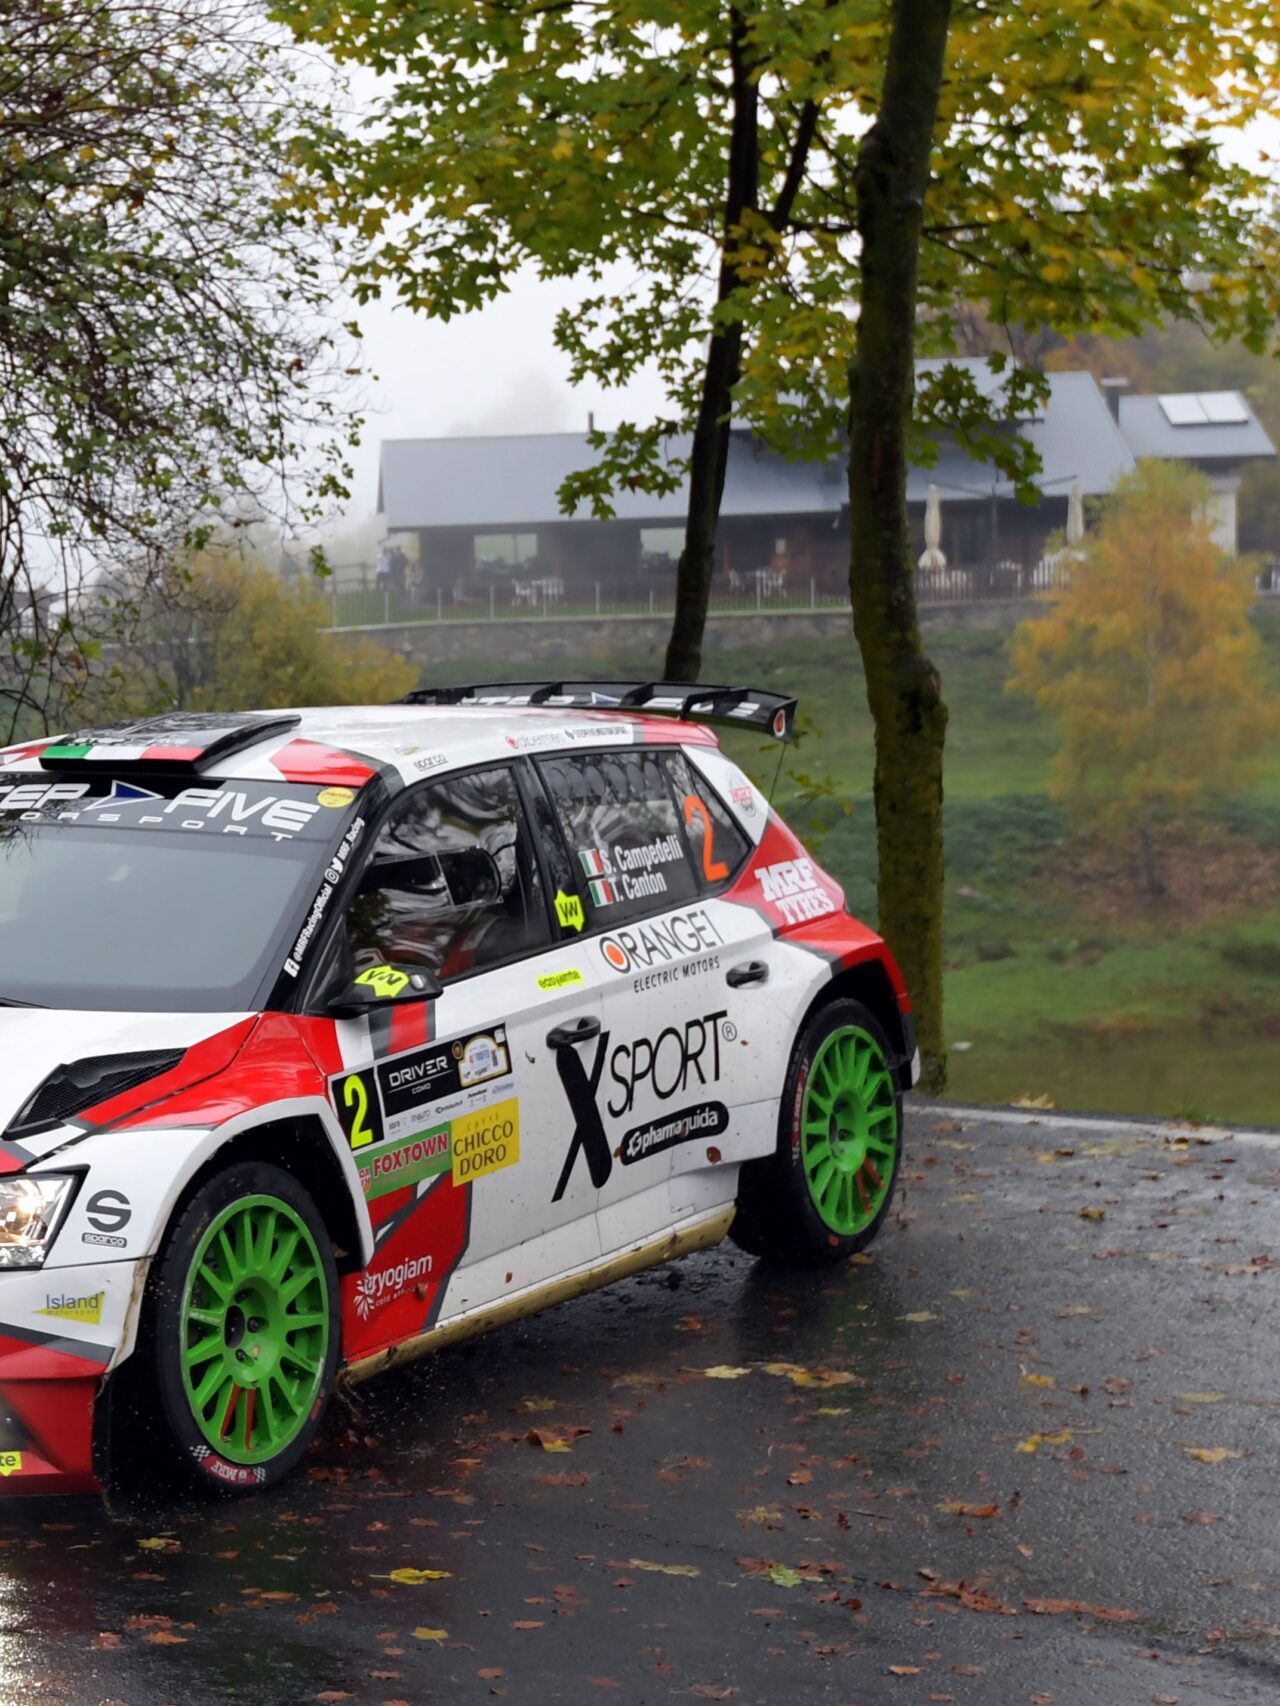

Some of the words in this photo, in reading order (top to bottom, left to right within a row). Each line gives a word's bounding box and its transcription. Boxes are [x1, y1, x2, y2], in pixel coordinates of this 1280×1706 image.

[163, 788, 320, 832] FIVE
[601, 850, 617, 874] S.
[614, 834, 684, 872] Campedelli
[683, 794, 730, 882] 2
[609, 877, 624, 902] T.
[622, 872, 667, 900] Canton
[754, 857, 818, 902] MRF
[775, 888, 835, 925] TYRES
[599, 910, 724, 974] ORANGE1
[633, 967, 678, 993] ELECTRIC
[682, 956, 720, 977] MOTORS
[388, 1056, 448, 1087] DRIVER
[344, 1074, 373, 1149] 2
[453, 1120, 514, 1157] CHICCO
[86, 1189, 132, 1233] S
[46, 1292, 99, 1310] Island
